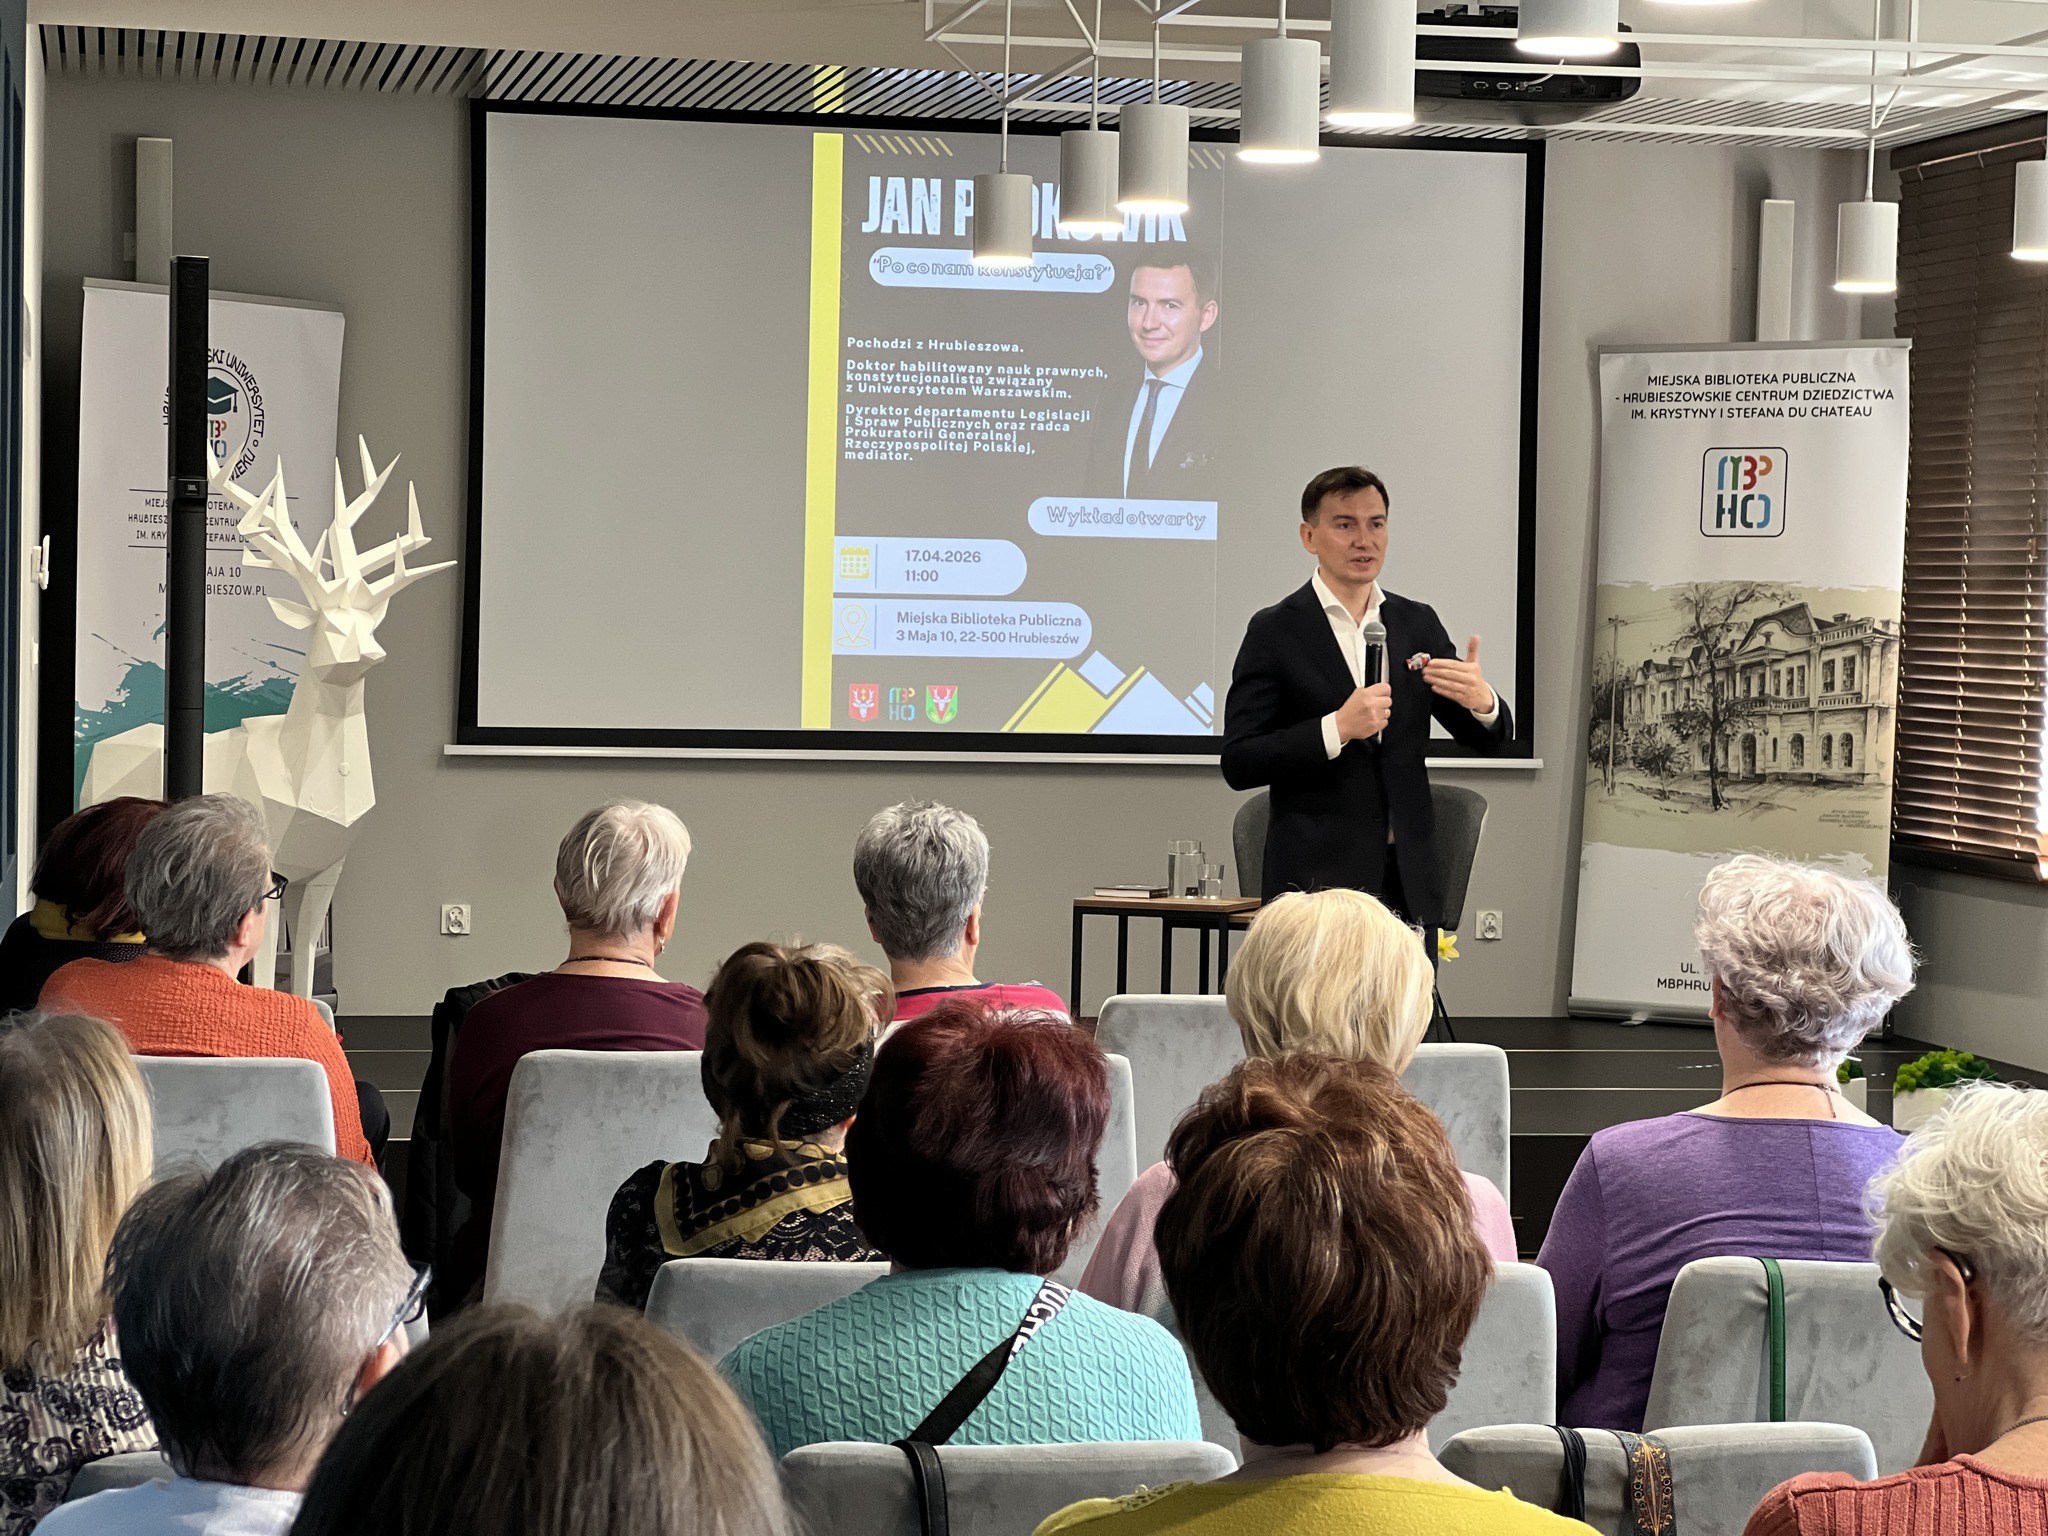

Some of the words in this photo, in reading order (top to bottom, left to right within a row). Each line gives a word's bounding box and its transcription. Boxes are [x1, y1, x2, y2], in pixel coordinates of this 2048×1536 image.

[862, 176, 942, 236] JAN
[847, 337, 912, 350] Pochodzi
[916, 341, 924, 350] z
[928, 339, 1024, 353] Hrubieszowa.
[846, 359, 895, 371] Doktor
[900, 361, 992, 376] habilitowany
[997, 364, 1031, 375] nauk
[1036, 366, 1108, 379] prawnych,
[846, 370, 983, 384] konstytucjonalista
[988, 375, 1053, 388] związany
[1647, 374, 1701, 386] MIEJSKA
[1704, 373, 1779, 385] BIBLIOTEKA
[1782, 372, 1856, 384] PUBLICZNA
[225, 351, 265, 438] UNIWERSYTET
[846, 384, 853, 393] z
[858, 382, 967, 396] Uniwersytetem
[971, 385, 1072, 399] Warszawskim.
[1623, 391, 1732, 403] HRUBIESZOWSKIE
[1735, 390, 1799, 402] CENTRUM
[1803, 389, 1895, 401] DZIEDZICTWA
[846, 404, 910, 417] Dyrektor
[914, 405, 1015, 419] departamentu
[1020, 408, 1090, 423] Legislacji
[1631, 408, 1647, 420] IM.
[1650, 407, 1716, 419] KRYSTYNY
[1719, 407, 1724, 418] I
[1727, 407, 1784, 418] STEFANA
[1788, 407, 1807, 418] DU
[1811, 406, 1873, 417] CHATEAU
[845, 415, 849, 426] i
[854, 416, 899, 428] Spraw
[904, 417, 990, 431] Publicznych
[995, 421, 1026, 431] oraz
[1030, 420, 1070, 432] radca
[845, 426, 933, 439] Prokuratorii
[938, 429, 1017, 443] Generalnej
[845, 438, 968, 453] Rzeczypospolitej
[973, 441, 1035, 455] Polskiej,
[845, 450, 913, 461] mediator.
[1047, 506, 1124, 527] Wykład
[1126, 510, 1206, 531] otwarty
[905, 550, 982, 564] 17.04.2026
[206, 566, 225, 577] AJA
[229, 566, 242, 578] 10
[905, 570, 939, 583] 11:00
[897, 611, 948, 626] Miejska
[950, 612, 1017, 626] Biblioteka
[1019, 614, 1082, 627] Publiczna
[896, 630, 905, 641] 3
[907, 630, 939, 644] Maja
[940, 631, 958, 644] 10,
[959, 631, 1006, 643] 22-500
[1008, 632, 1080, 645] Hrubieszów
[1680, 962, 1700, 974] UL.
[1657, 977, 1711, 992] MBPHRU
